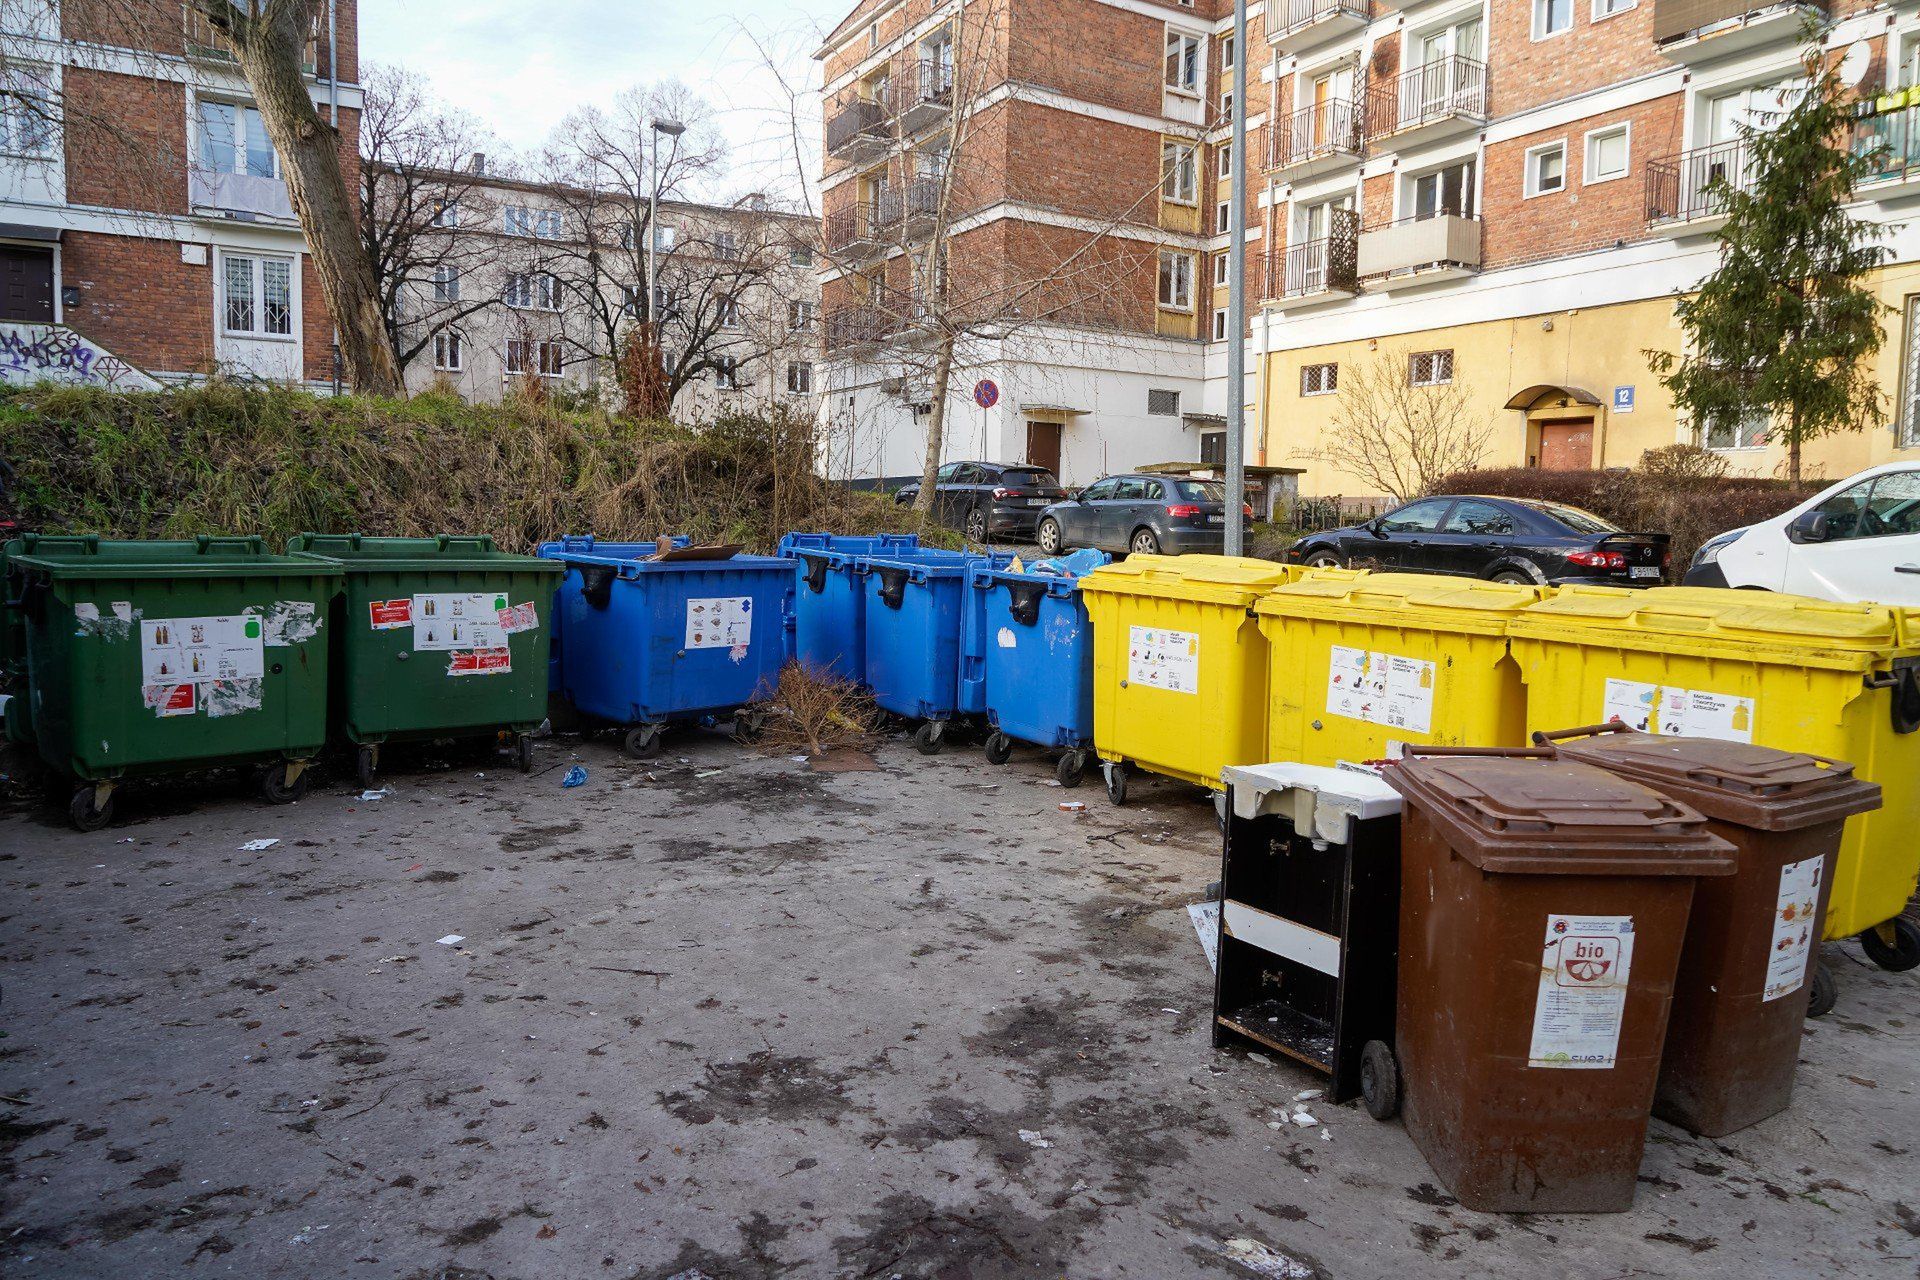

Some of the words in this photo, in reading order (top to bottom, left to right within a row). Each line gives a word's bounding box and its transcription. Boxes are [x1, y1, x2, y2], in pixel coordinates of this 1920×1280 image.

[1618, 389, 1630, 403] 12
[1693, 693, 1713, 701] Metale
[1696, 699, 1726, 708] tworzywa
[1575, 942, 1605, 959] bio
